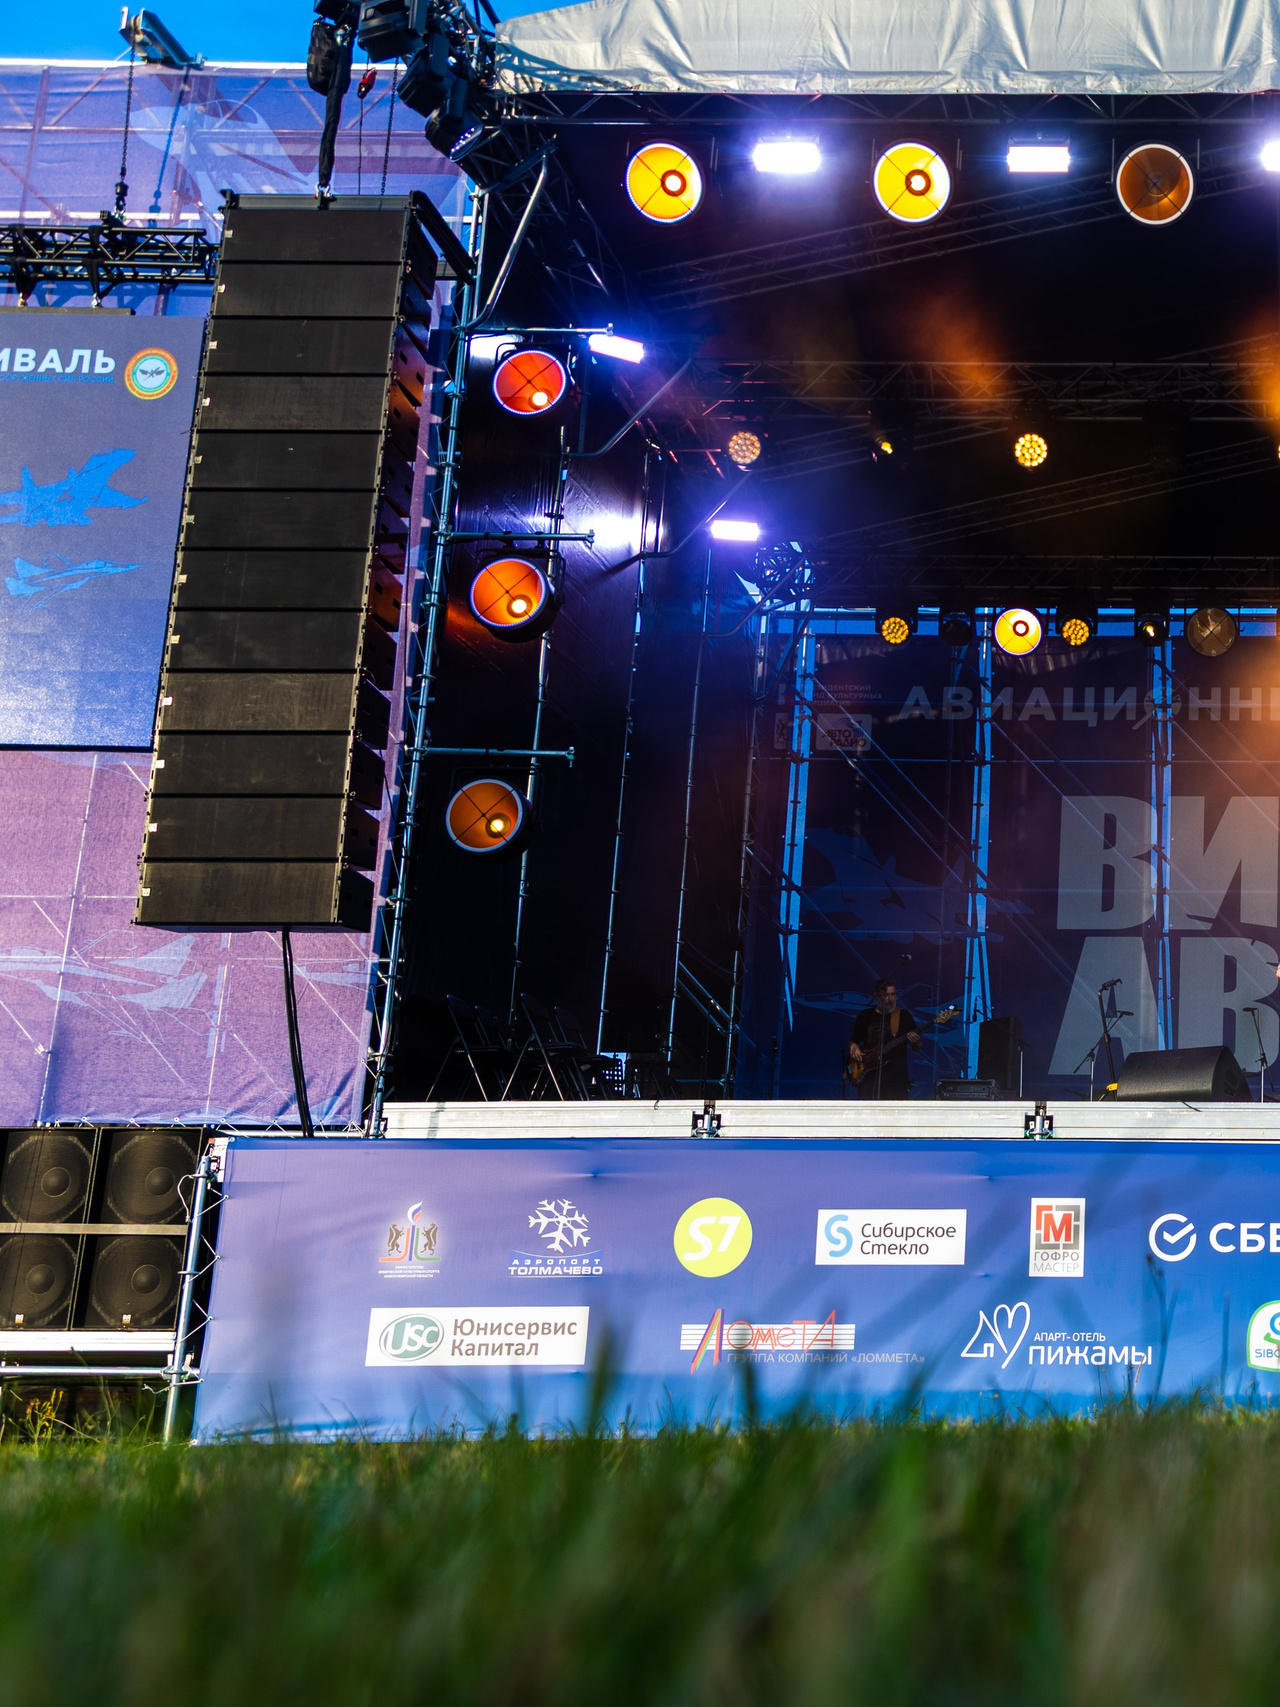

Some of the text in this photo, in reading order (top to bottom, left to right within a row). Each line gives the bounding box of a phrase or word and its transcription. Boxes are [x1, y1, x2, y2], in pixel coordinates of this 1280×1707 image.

[78, 375, 114, 383] РОССИИ
[683, 1216, 742, 1261] S7
[861, 1222, 957, 1244] Сибирское
[860, 1240, 930, 1256] Стекло
[1034, 1250, 1080, 1263] ГОФРО
[508, 1266, 603, 1275] ТОЛМАЧЕВО
[1033, 1262, 1080, 1273] МАСТЕР
[453, 1318, 578, 1340] Юнисервис
[384, 1321, 439, 1355] USC
[451, 1339, 539, 1357] Капитал
[727, 1351, 925, 1364] ГРУППА КОМПАНИЙ «ЛОММЕТА»
